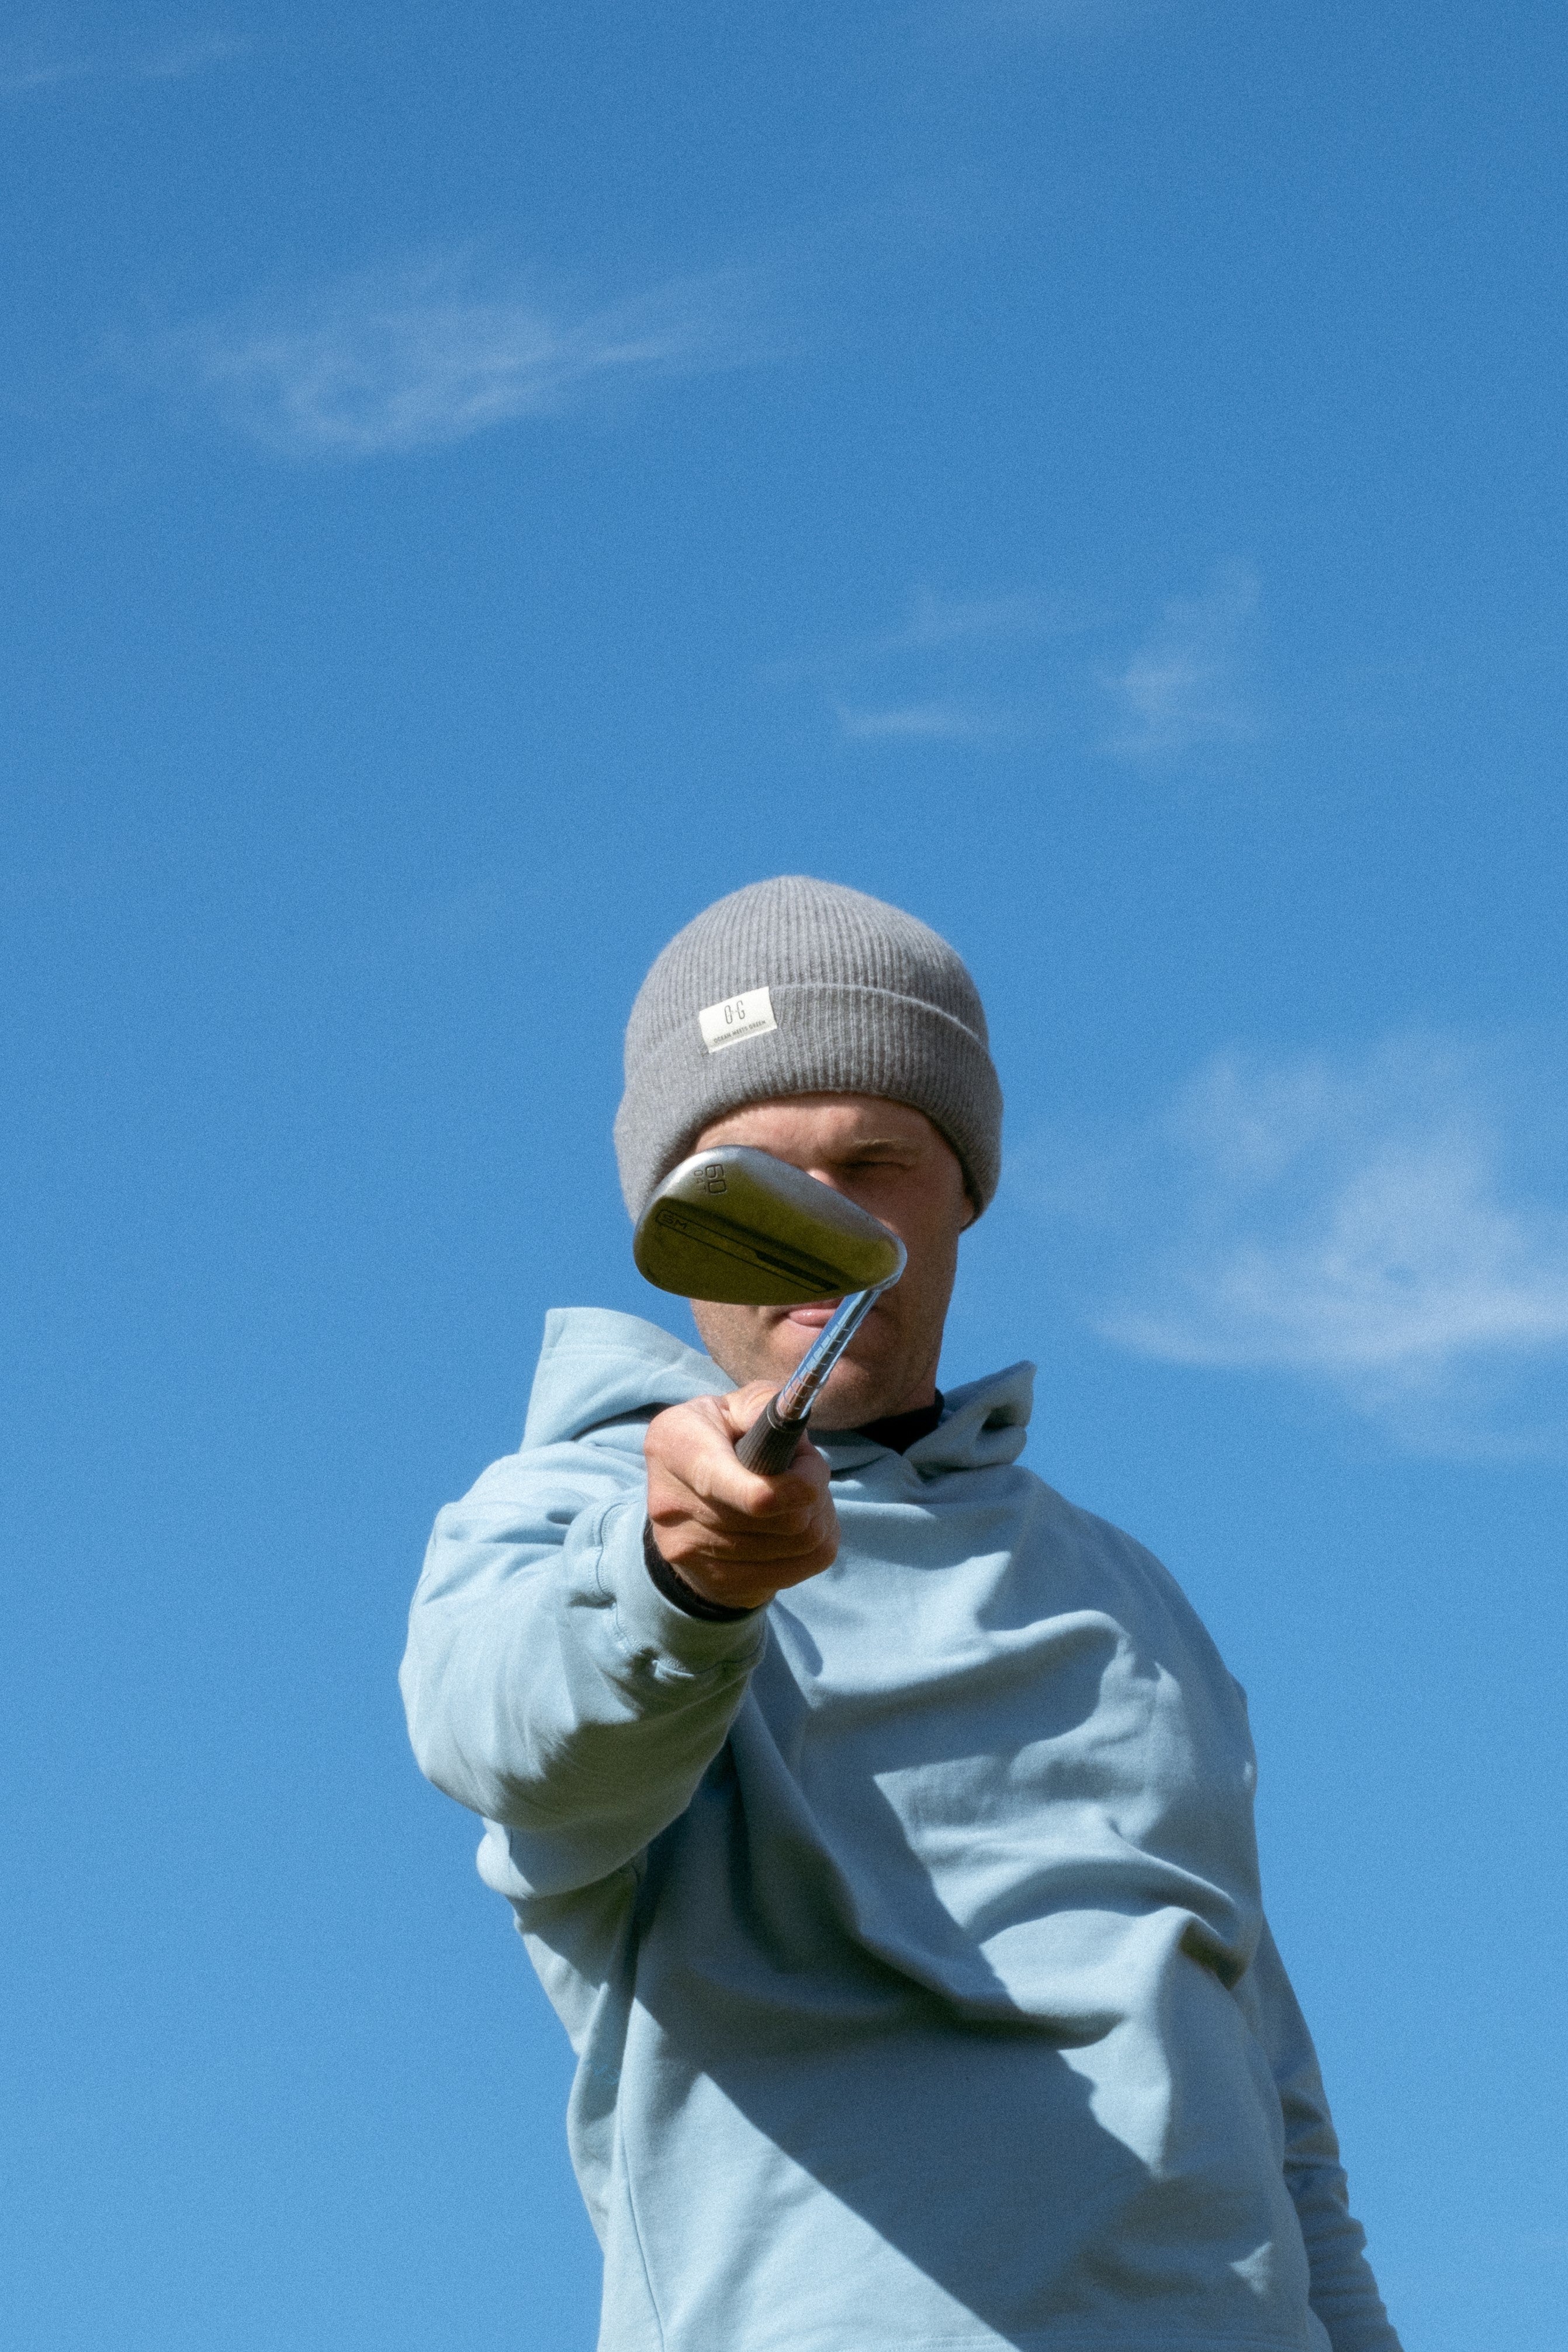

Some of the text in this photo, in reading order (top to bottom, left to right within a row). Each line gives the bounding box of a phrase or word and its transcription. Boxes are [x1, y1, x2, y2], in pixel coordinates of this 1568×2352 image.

[714, 1020, 766, 1043] OCEAN MEETS GREEN
[705, 1164, 726, 1194] 60
